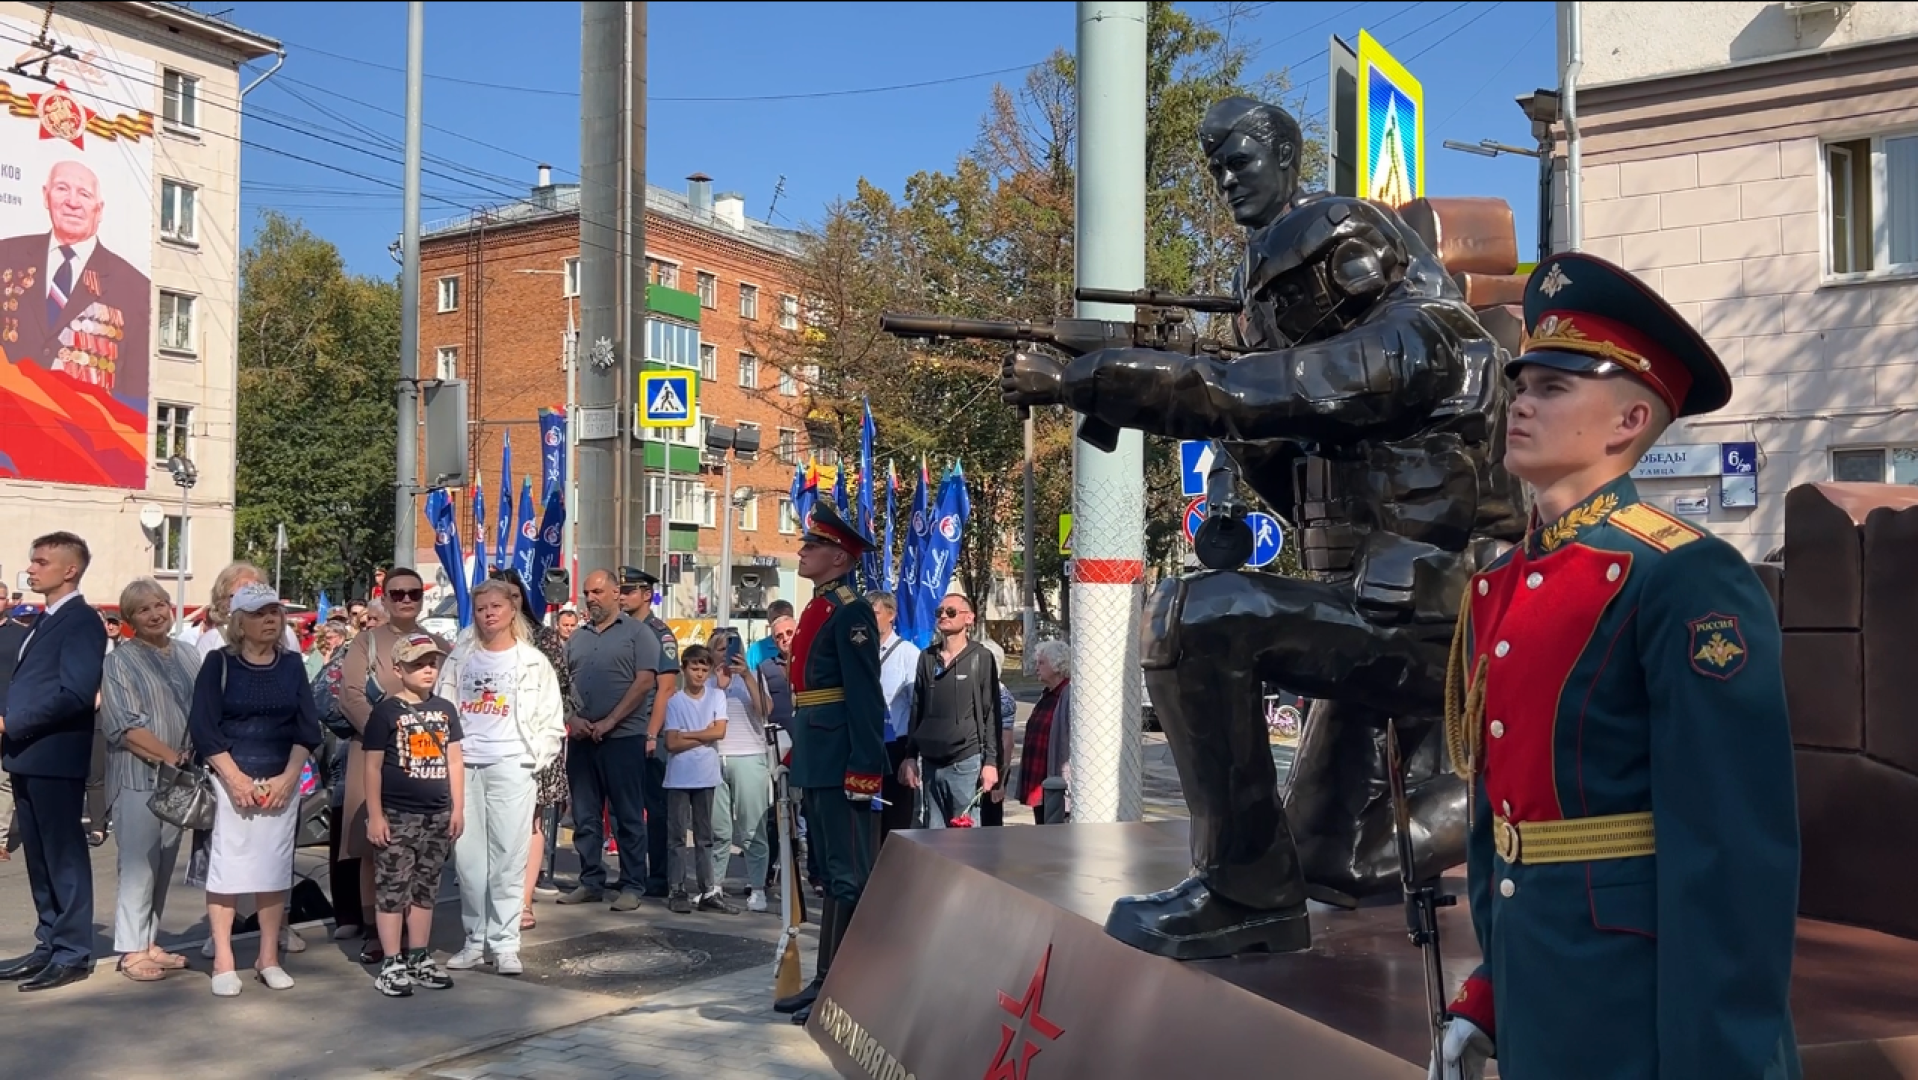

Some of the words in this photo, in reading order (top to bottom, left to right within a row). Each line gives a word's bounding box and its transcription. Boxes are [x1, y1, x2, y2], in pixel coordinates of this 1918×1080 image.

[1639, 452, 1686, 464] ОБЕДЫ
[1639, 468, 1676, 476] УЛИЦА
[1696, 619, 1734, 633] РОССИЯ
[460, 701, 510, 717] MOUSE
